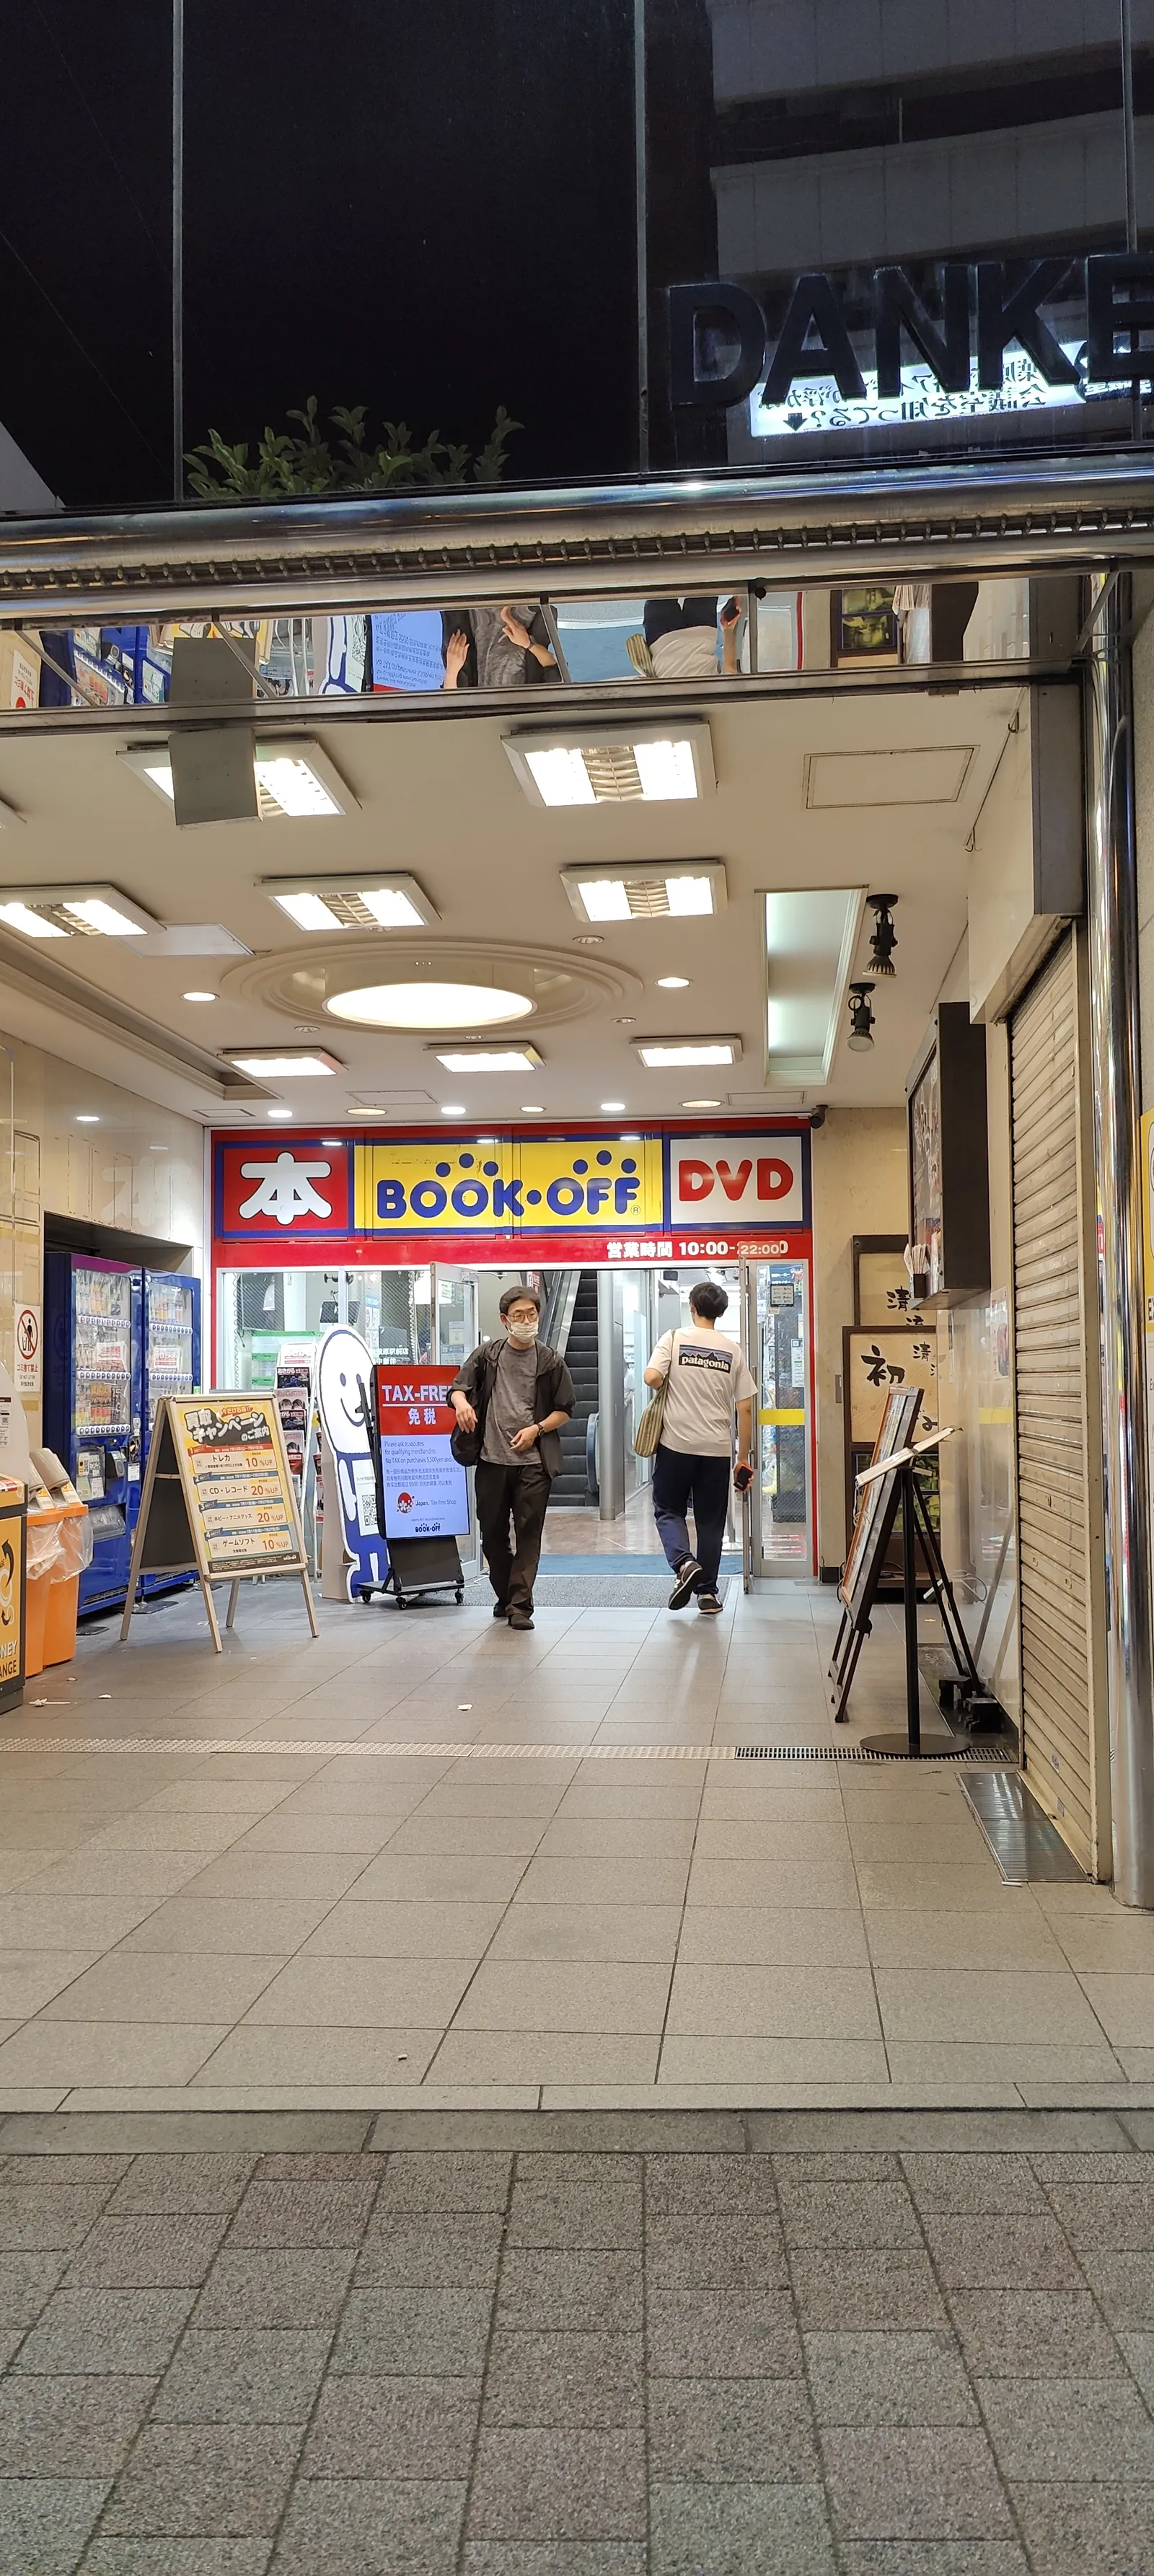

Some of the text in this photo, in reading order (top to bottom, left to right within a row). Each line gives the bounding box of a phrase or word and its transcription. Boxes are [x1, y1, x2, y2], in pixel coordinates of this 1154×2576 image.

[669, 254, 1154, 408] DANKE
[239, 1151, 332, 1226] 本
[678, 1158, 794, 1202] DVD
[607, 1241, 673, 1258] 営業時間
[682, 1355, 729, 1371] patagonia
[860, 1345, 905, 1386] 初
[382, 1385, 452, 1402] TAX-FRE
[193, 1412, 264, 1443] キャンペーン
[241, 1425, 270, 1441] のご案内
[212, 1454, 231, 1463] トレカ
[245, 1457, 258, 1468] 10
[251, 1485, 263, 1495] 20
[257, 1513, 270, 1523] 20
[222, 1537, 255, 1547] ゲームソフト
[263, 1539, 274, 1550] 10
